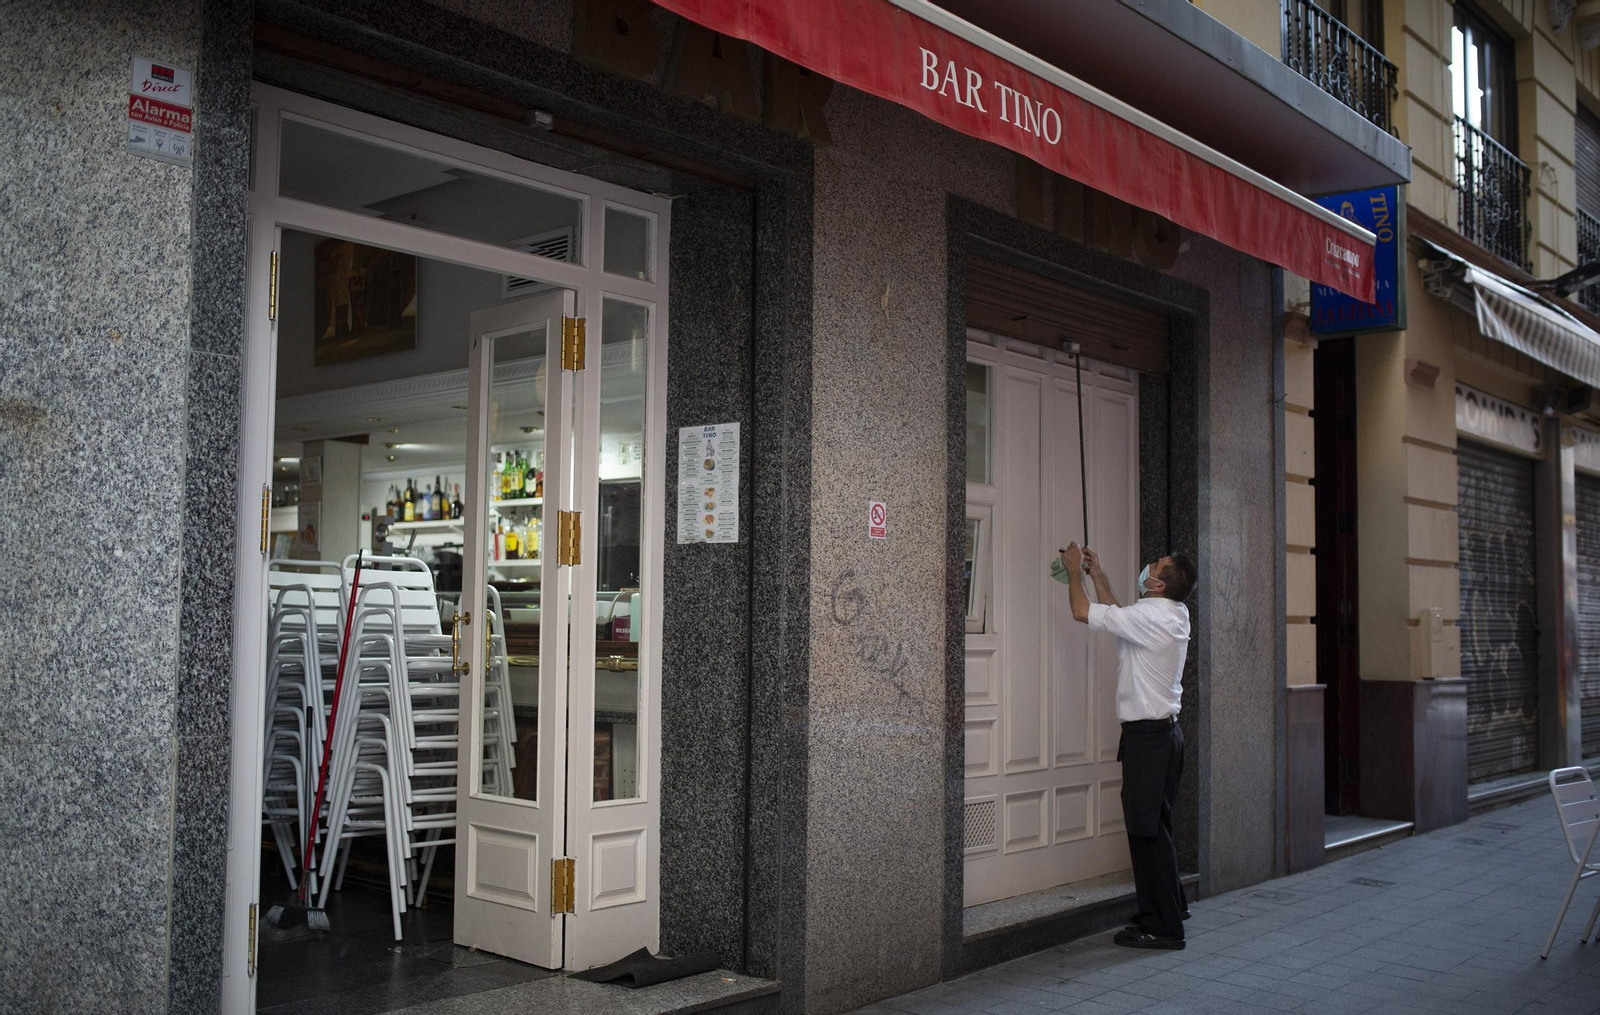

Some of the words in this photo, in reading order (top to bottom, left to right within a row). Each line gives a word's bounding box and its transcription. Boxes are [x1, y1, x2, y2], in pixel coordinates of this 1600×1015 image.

[142, 78, 183, 92] Direct
[919, 46, 987, 113] BAR
[994, 81, 1062, 145] TINO
[131, 98, 190, 124] Alarma
[131, 111, 143, 119] con
[144, 114, 162, 124] Aviso
[1370, 193, 1393, 243] TINO
